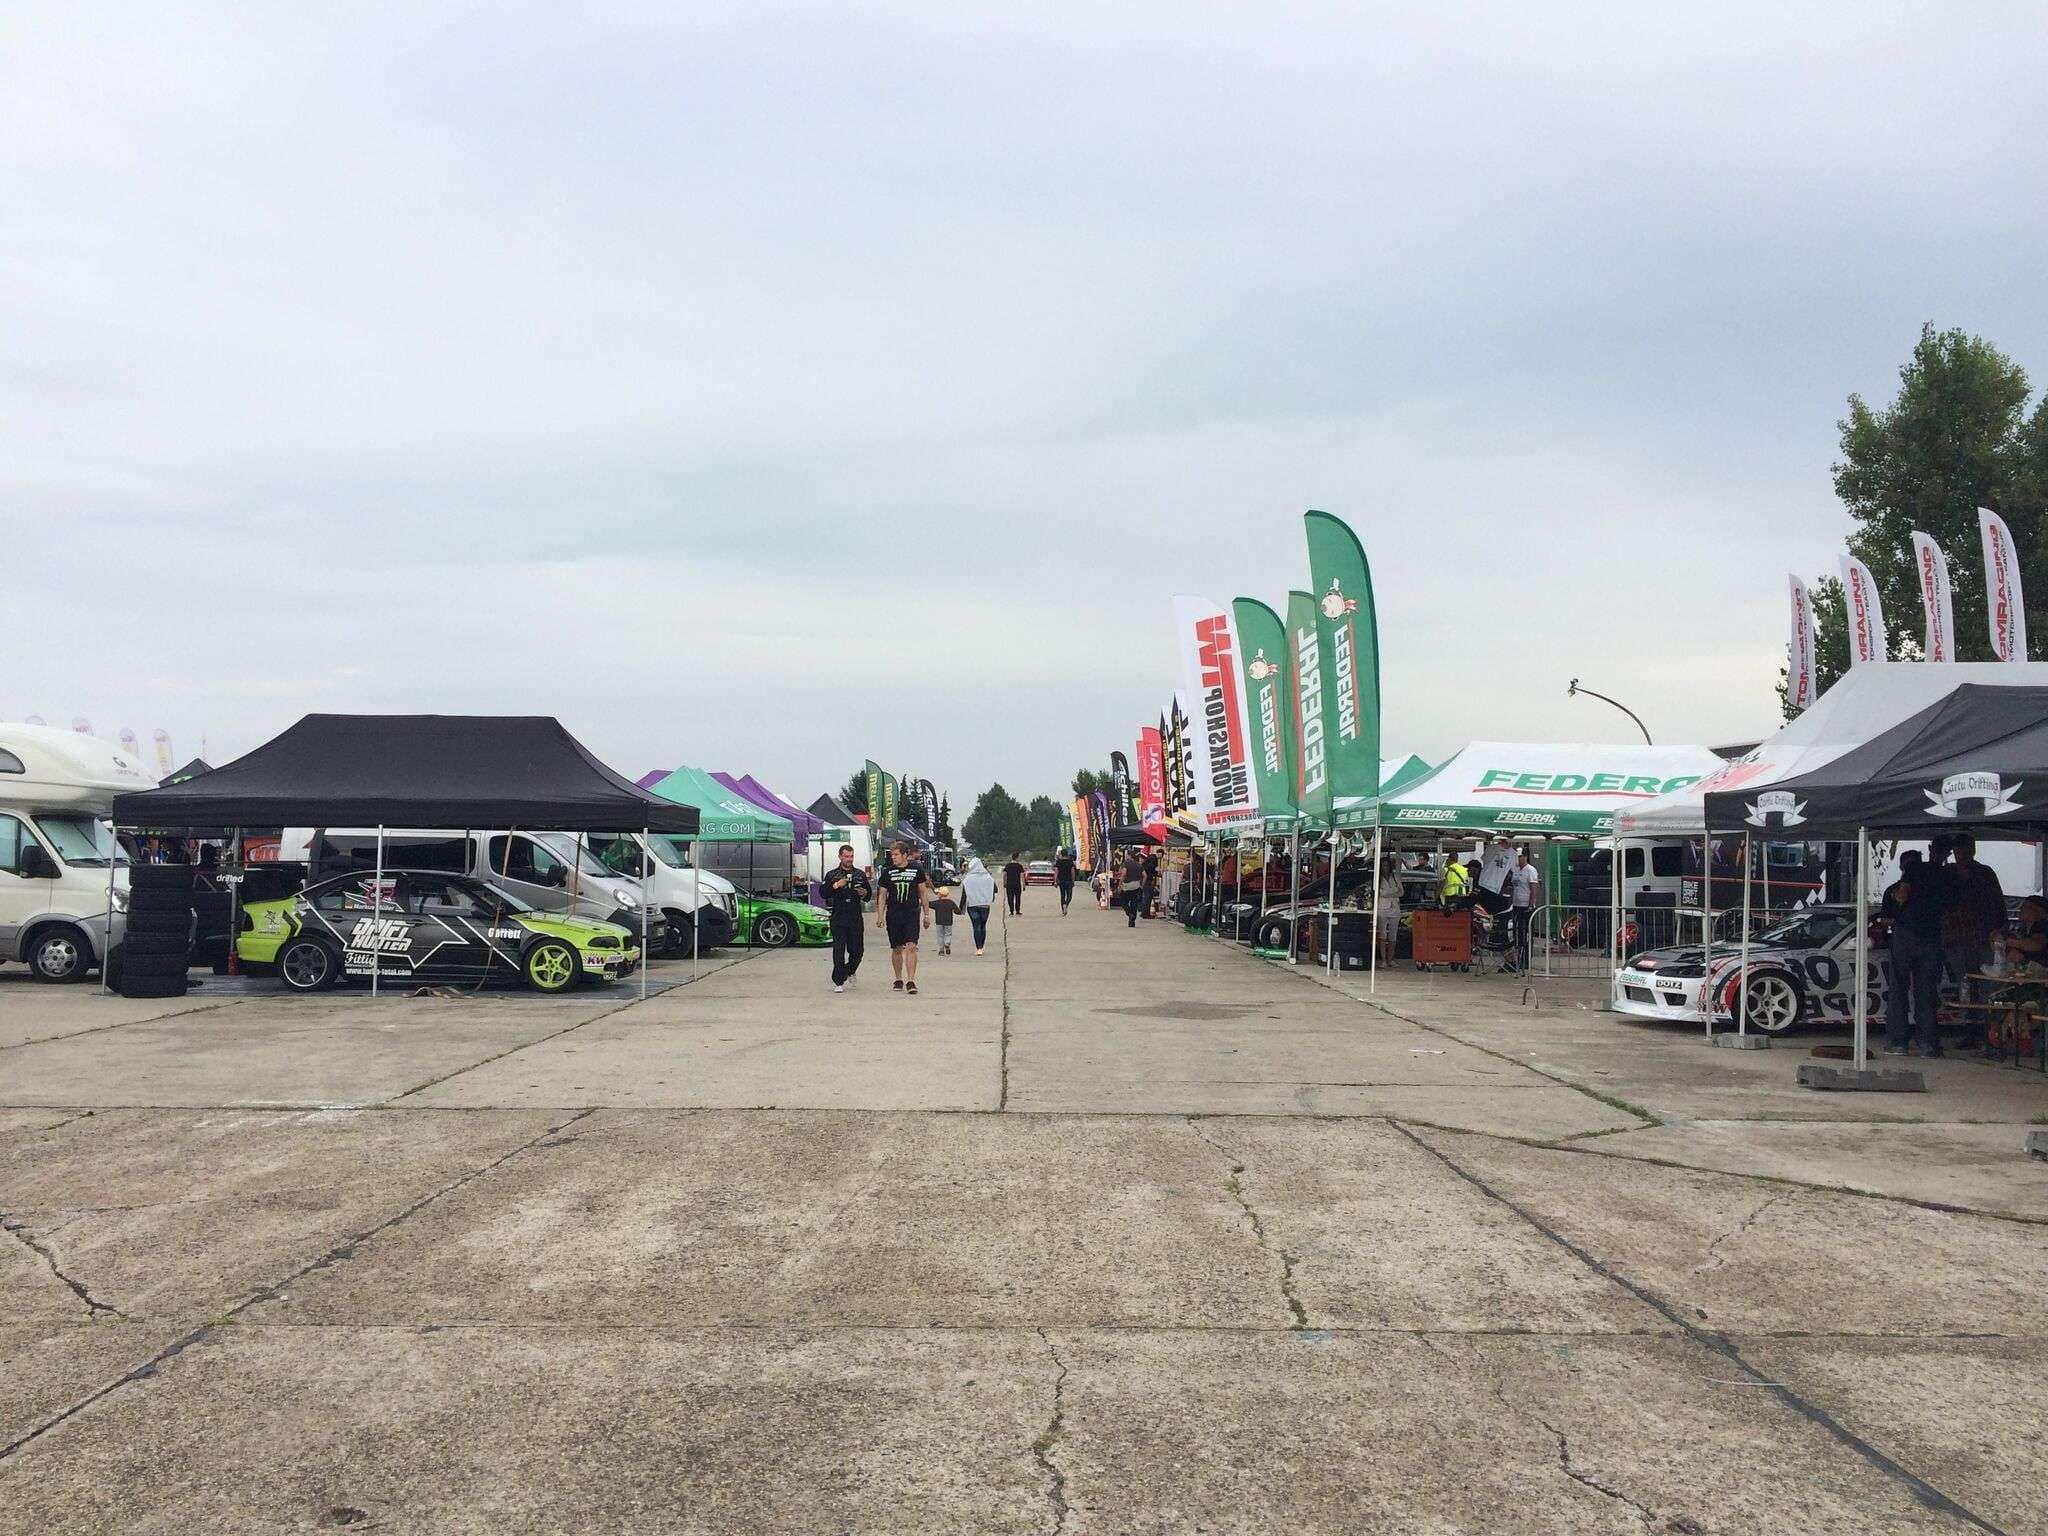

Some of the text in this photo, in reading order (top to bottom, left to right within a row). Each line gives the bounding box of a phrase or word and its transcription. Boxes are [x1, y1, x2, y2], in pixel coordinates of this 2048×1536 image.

[1478, 769, 1701, 793] FEDERA
[1118, 759, 1129, 825] Achilles
[925, 785, 936, 837] Achilles
[1398, 808, 1458, 819] FEDERAL
[1496, 811, 1557, 824] FEDERAL
[1657, 980, 1681, 989] DOTZ
